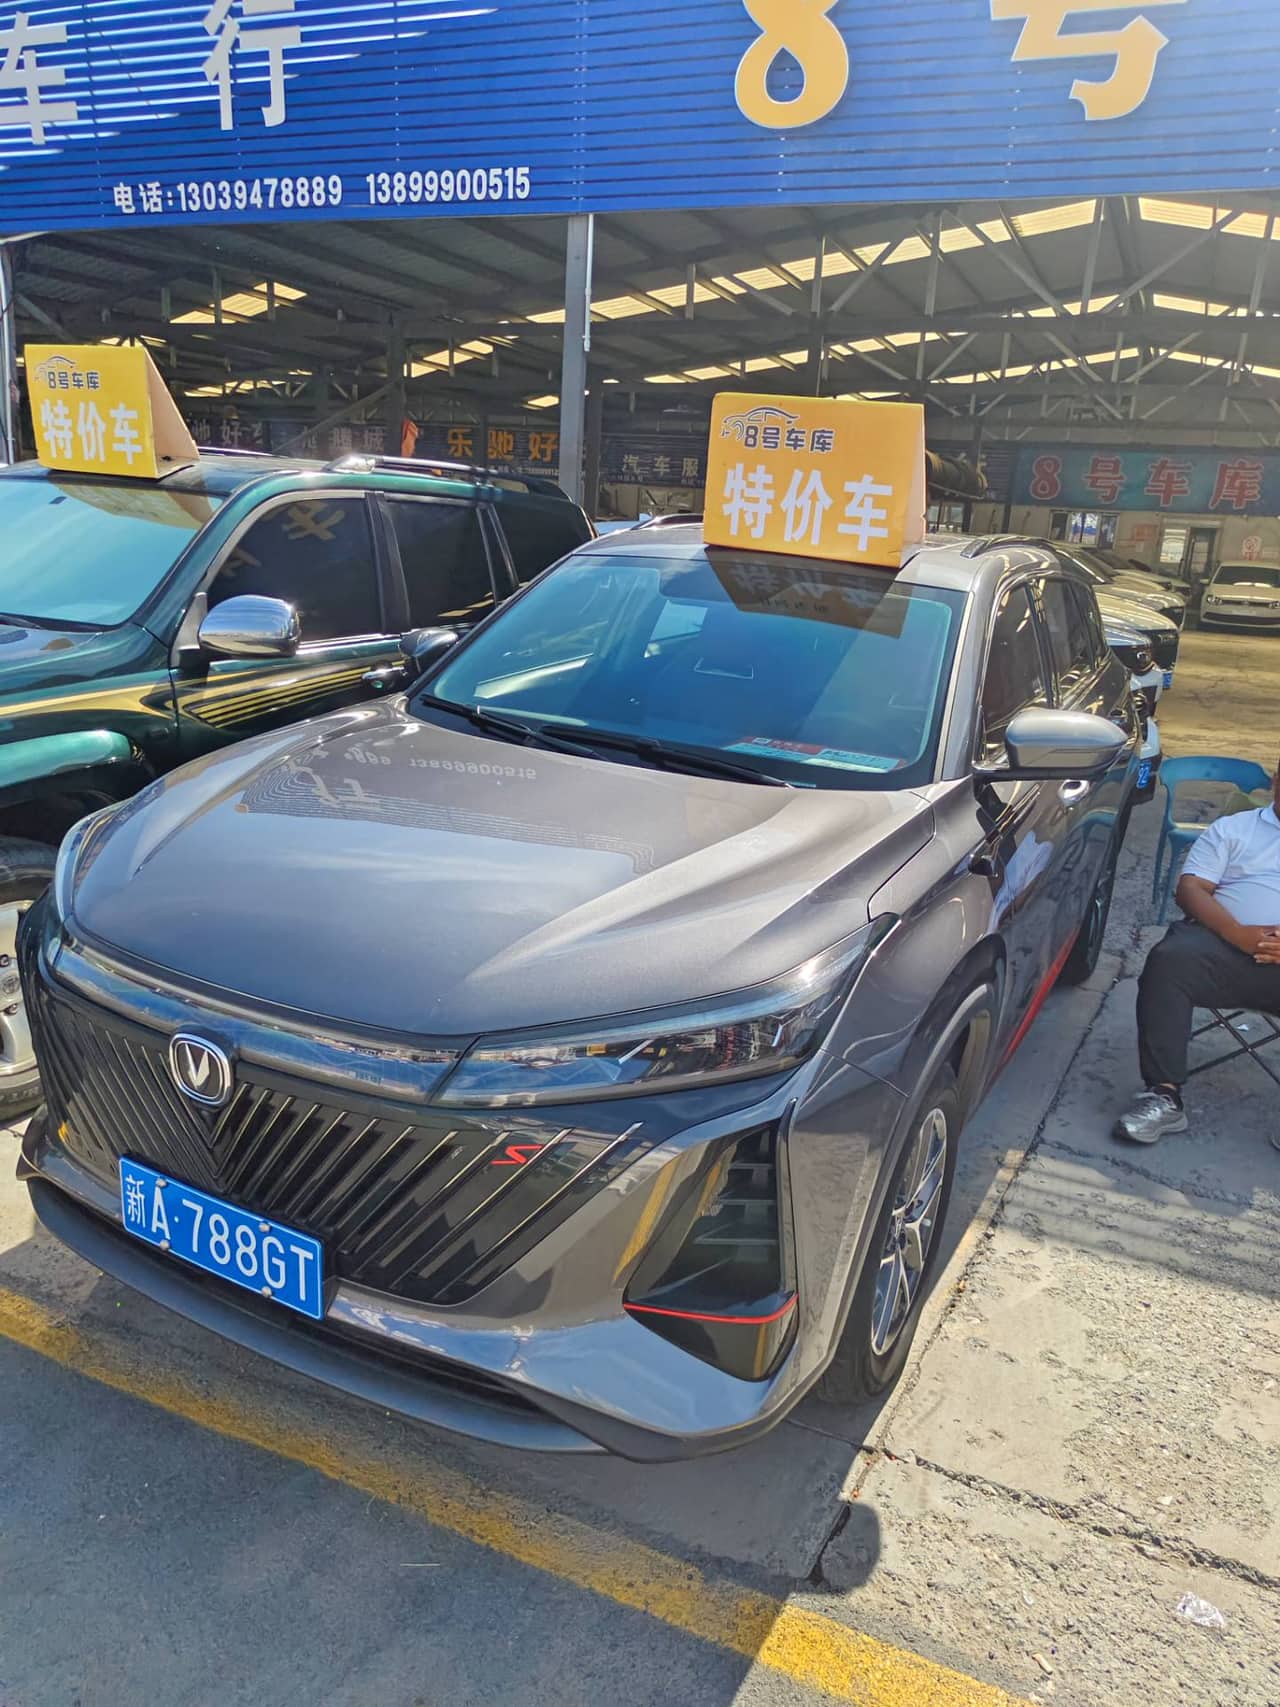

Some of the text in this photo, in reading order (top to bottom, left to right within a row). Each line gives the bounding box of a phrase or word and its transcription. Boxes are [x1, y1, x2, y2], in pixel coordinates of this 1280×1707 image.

[113, 166, 530, 214] 电话:13039478889 13899900515
[47, 371, 100, 390] 8号车库
[40, 399, 143, 464] 特价车
[743, 425, 835, 454] 8号车库
[722, 463, 893, 551] 特价车
[1030, 455, 1264, 511] 8号车库
